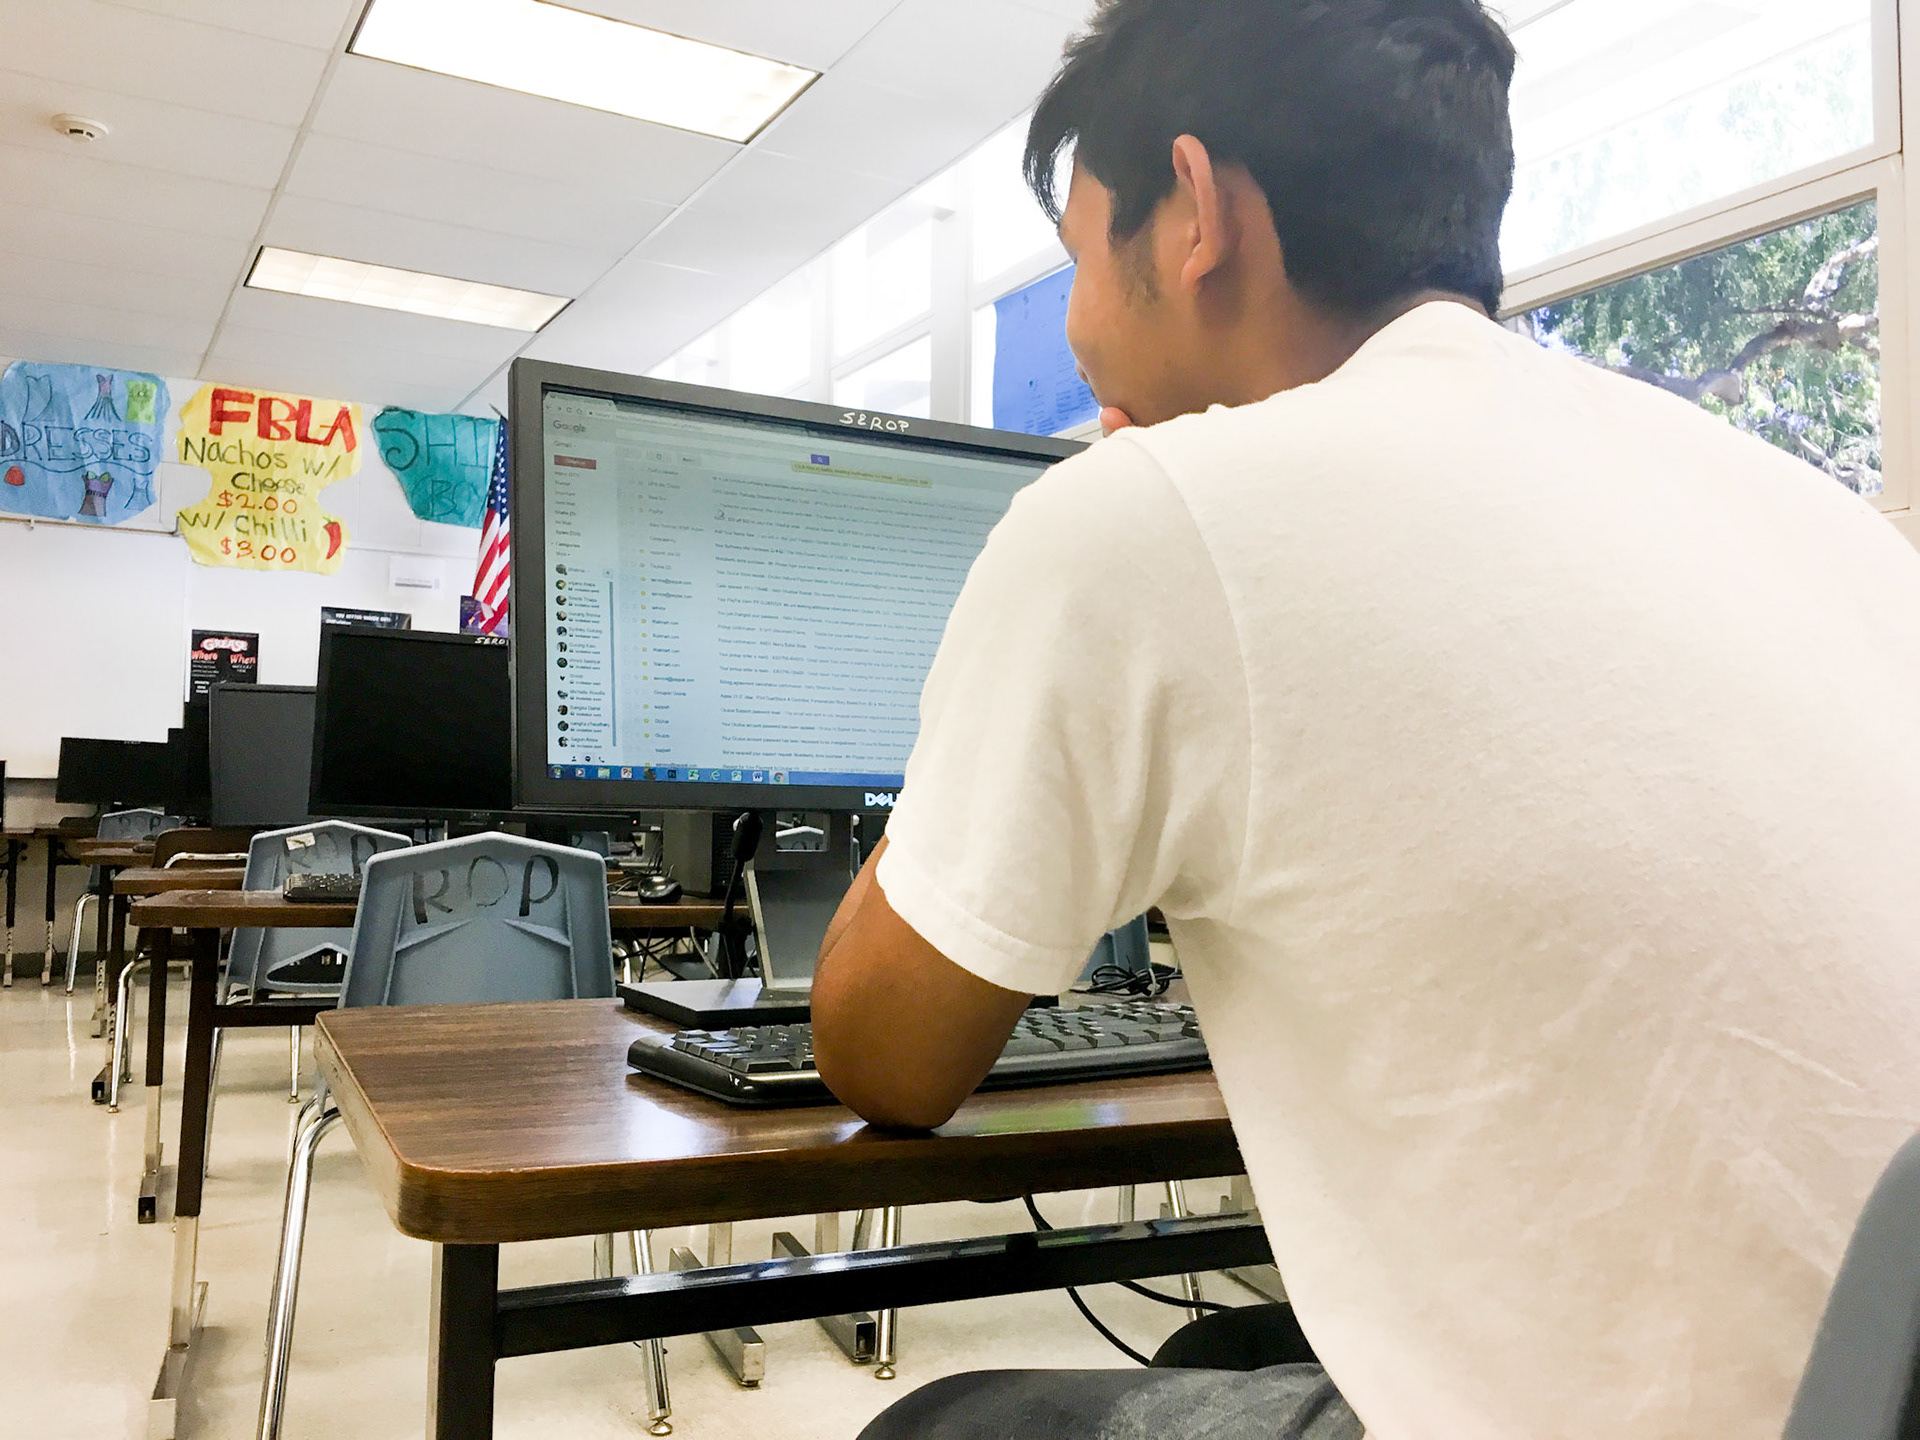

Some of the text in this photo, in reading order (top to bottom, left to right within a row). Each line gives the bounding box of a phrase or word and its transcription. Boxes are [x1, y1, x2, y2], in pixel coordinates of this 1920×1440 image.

[208, 388, 357, 453] FBLA
[0, 420, 153, 462] DRESSES
[184, 437, 288, 469] Nachos
[216, 489, 297, 514] $2.00
[234, 514, 307, 542] Chilli
[220, 536, 297, 563] $3.00
[230, 653, 256, 664] When
[412, 854, 559, 924] ROP
